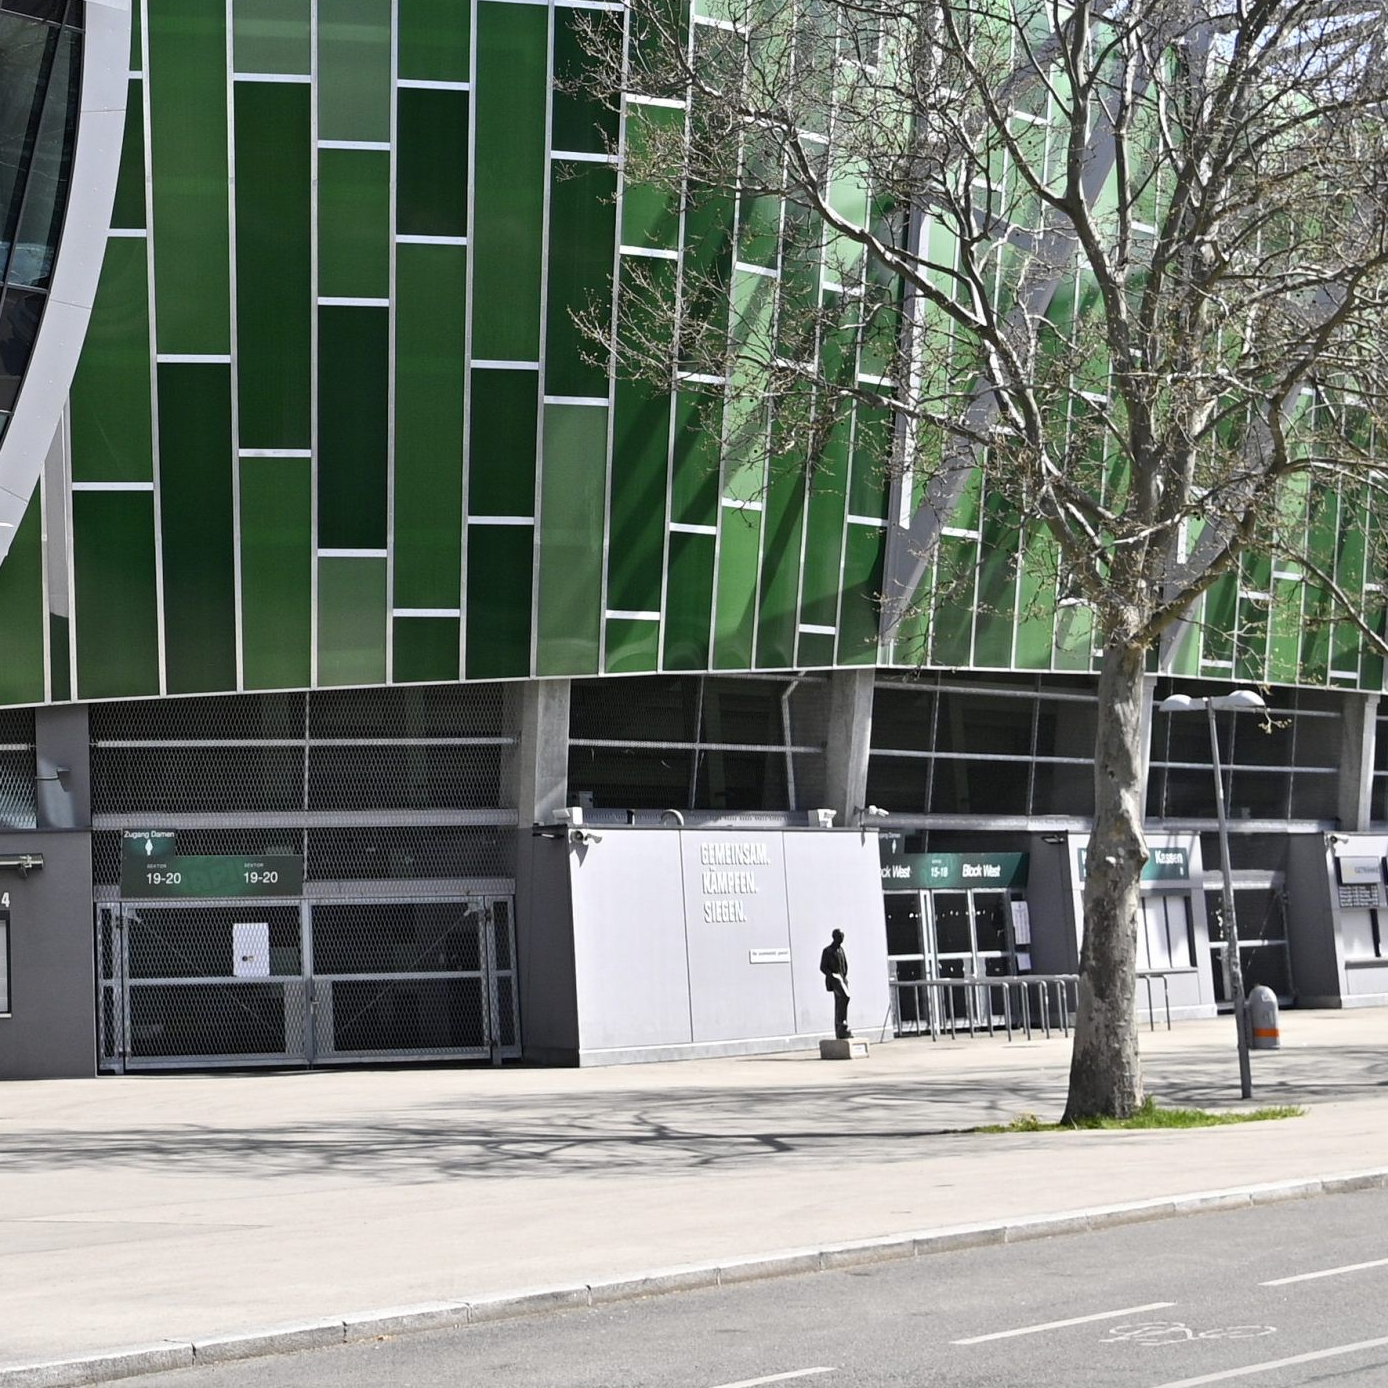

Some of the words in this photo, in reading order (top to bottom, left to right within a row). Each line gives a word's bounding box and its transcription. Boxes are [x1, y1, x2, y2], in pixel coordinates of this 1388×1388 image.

[124, 831, 149, 840] Zugang
[701, 842, 771, 865] GEMEINSAM.
[1155, 850, 1184, 864] Kassen
[243, 871, 278, 883] 19-20
[892, 864, 910, 878] West
[931, 866, 949, 878] 15-18
[962, 863, 982, 877] Block
[983, 864, 1001, 877] West
[146, 872, 181, 884] 19-20
[702, 868, 759, 894] KÄMPFEN.
[1, 892, 10, 908] 4
[704, 900, 748, 923] SIEGEN.
